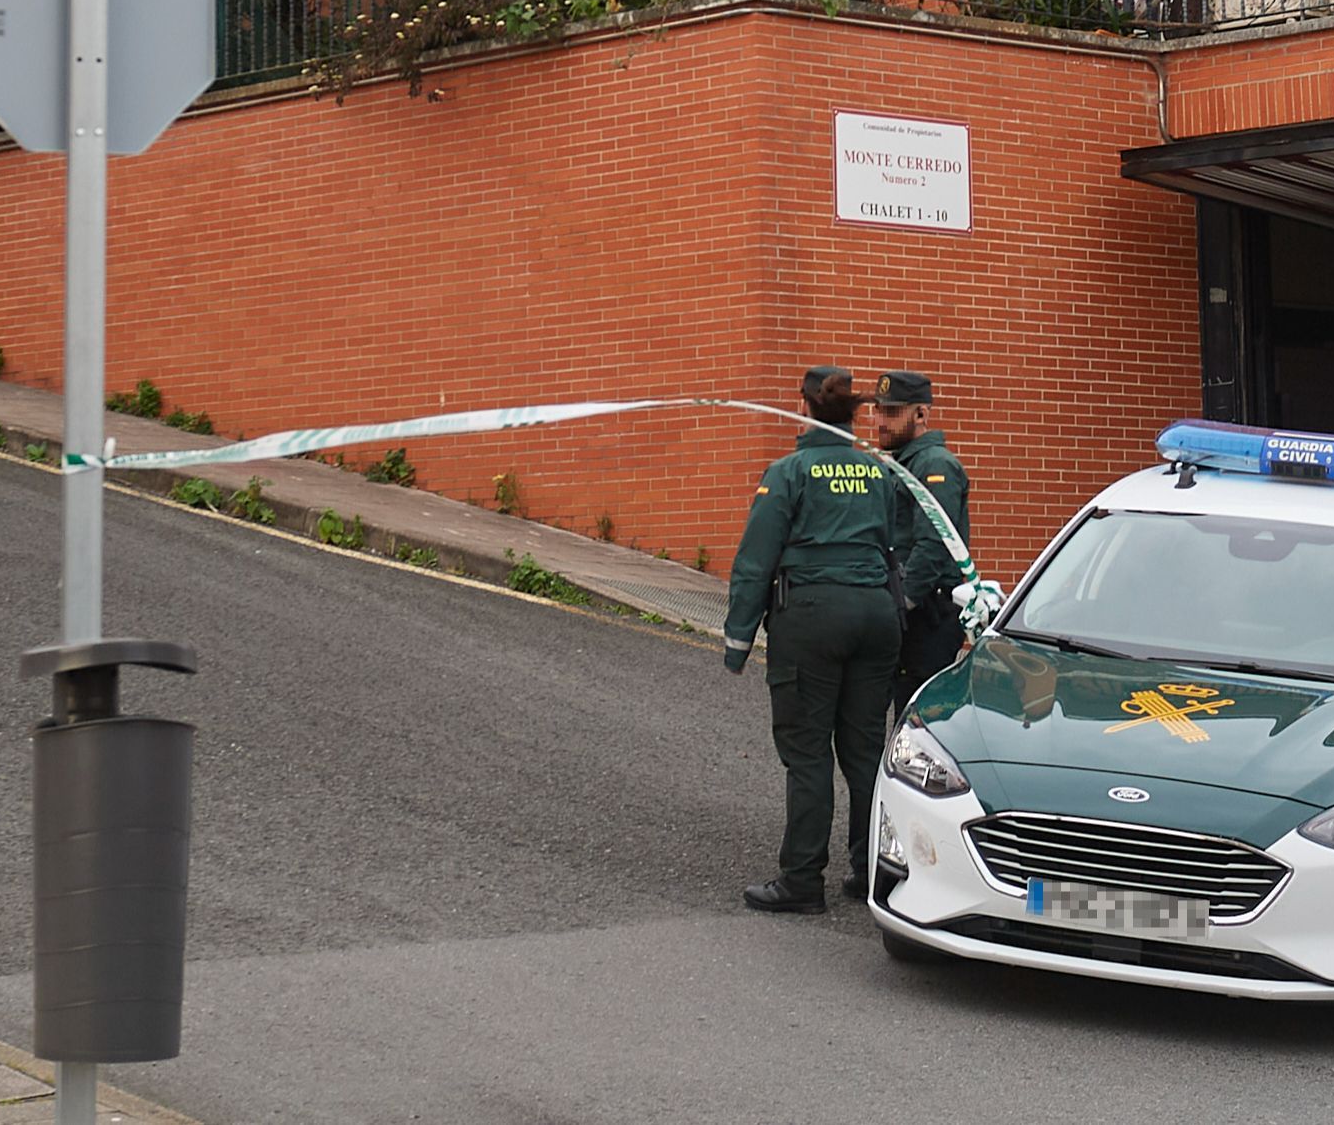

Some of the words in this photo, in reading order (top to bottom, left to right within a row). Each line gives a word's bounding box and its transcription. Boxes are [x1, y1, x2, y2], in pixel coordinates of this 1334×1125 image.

[844, 149, 893, 168] MONTE
[897, 155, 962, 175] CERREDO
[920, 176, 927, 187] 2
[860, 202, 913, 219] CHALET
[917, 208, 923, 221] 1
[936, 209, 948, 223] 10
[1267, 438, 1334, 454] GUARDIA
[1278, 450, 1319, 465] CIVIL
[810, 463, 883, 479] GUARDIA
[829, 479, 869, 495] CIVIL
